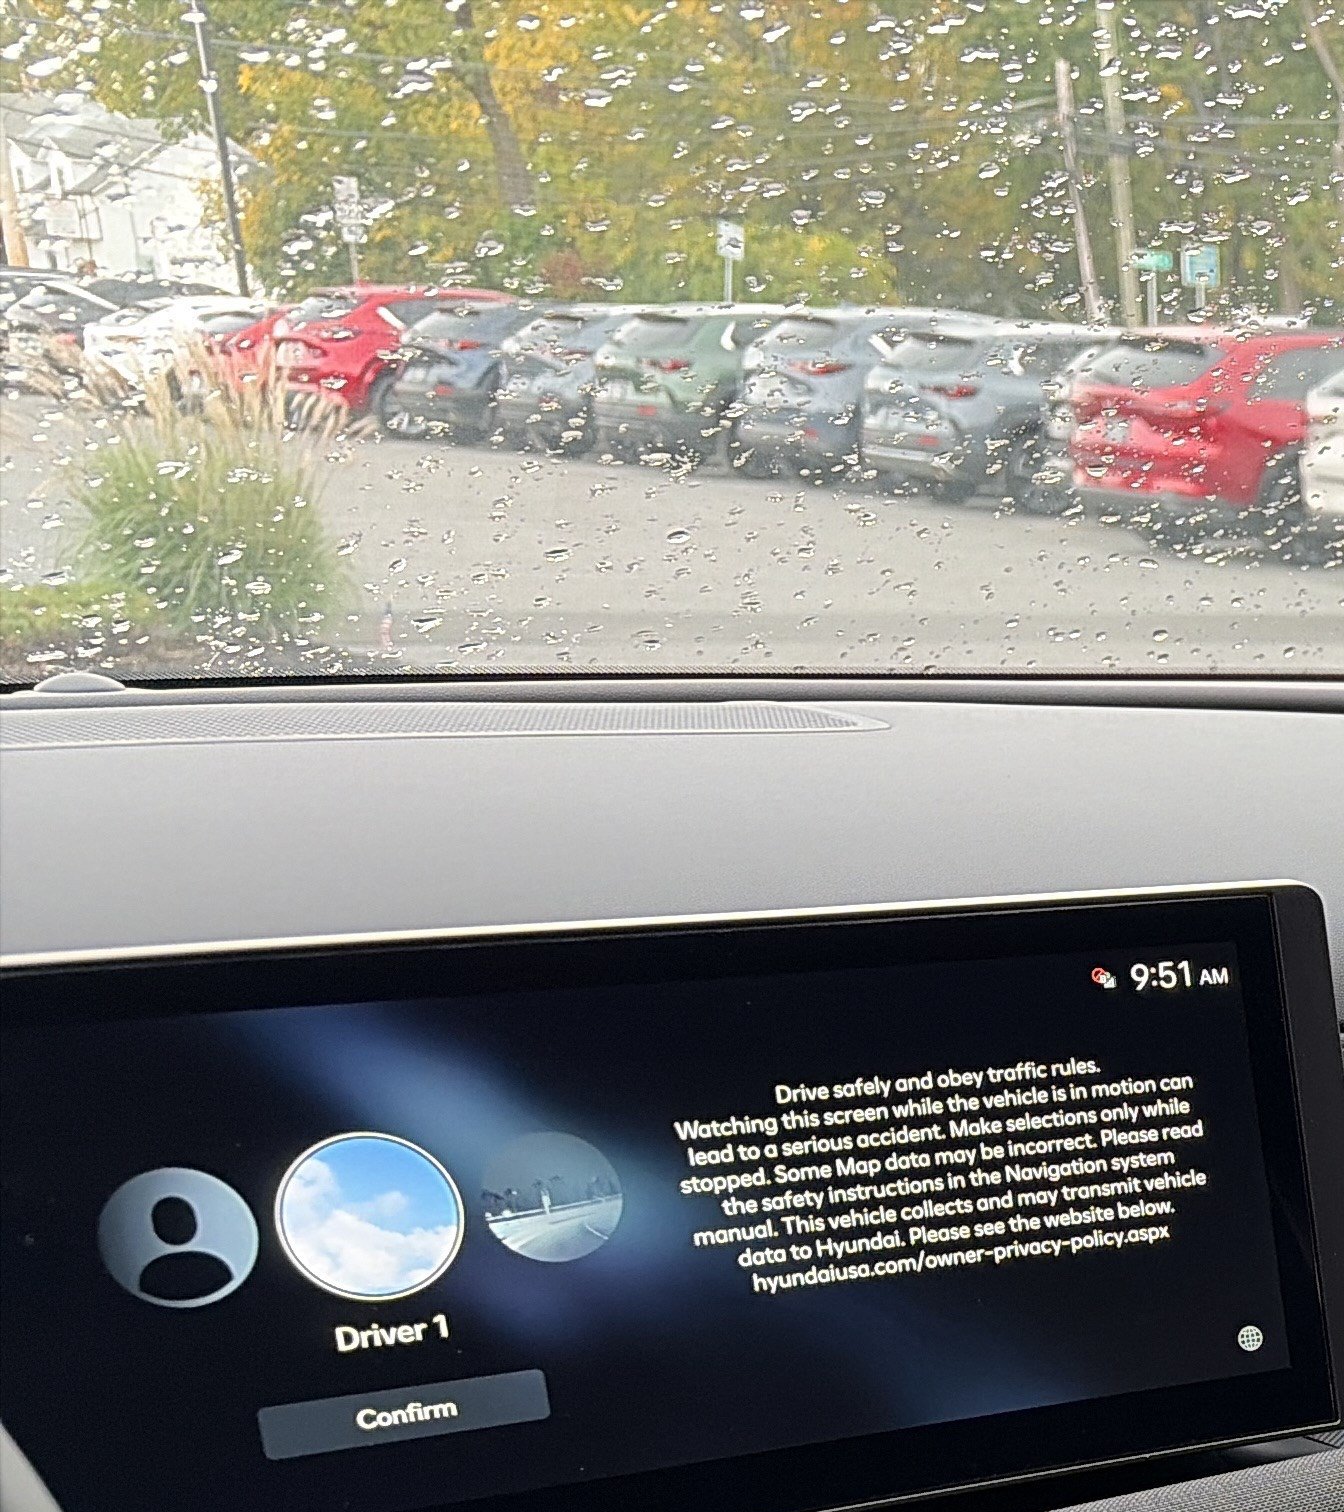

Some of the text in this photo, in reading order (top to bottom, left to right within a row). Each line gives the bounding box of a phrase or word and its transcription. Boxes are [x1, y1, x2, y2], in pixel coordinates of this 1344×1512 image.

[1130, 960, 1229, 992] 9:51 AM
[674, 1075, 1193, 1140] Watching this screen while the vehicle is in motion can
[775, 1057, 1101, 1104] Drive safely and obey traffic rules.
[680, 1119, 1203, 1195] stopped. Some Map data may be incorrect. Please read
[687, 1097, 1190, 1167] lead to a serious accident. Make selections only while
[693, 1169, 1207, 1247] manual. This vehicle collects and may transmit vehicle
[721, 1151, 1175, 1216] the safety instructions in the Navigation system
[738, 1199, 1176, 1267] data to Hyundai. Please see the website below.
[753, 1224, 1170, 1294] hyundaiusa.com/owner-privacy-policy.aspx
[335, 1312, 449, 1351] Driver 1
[355, 1398, 458, 1430] Confirm
